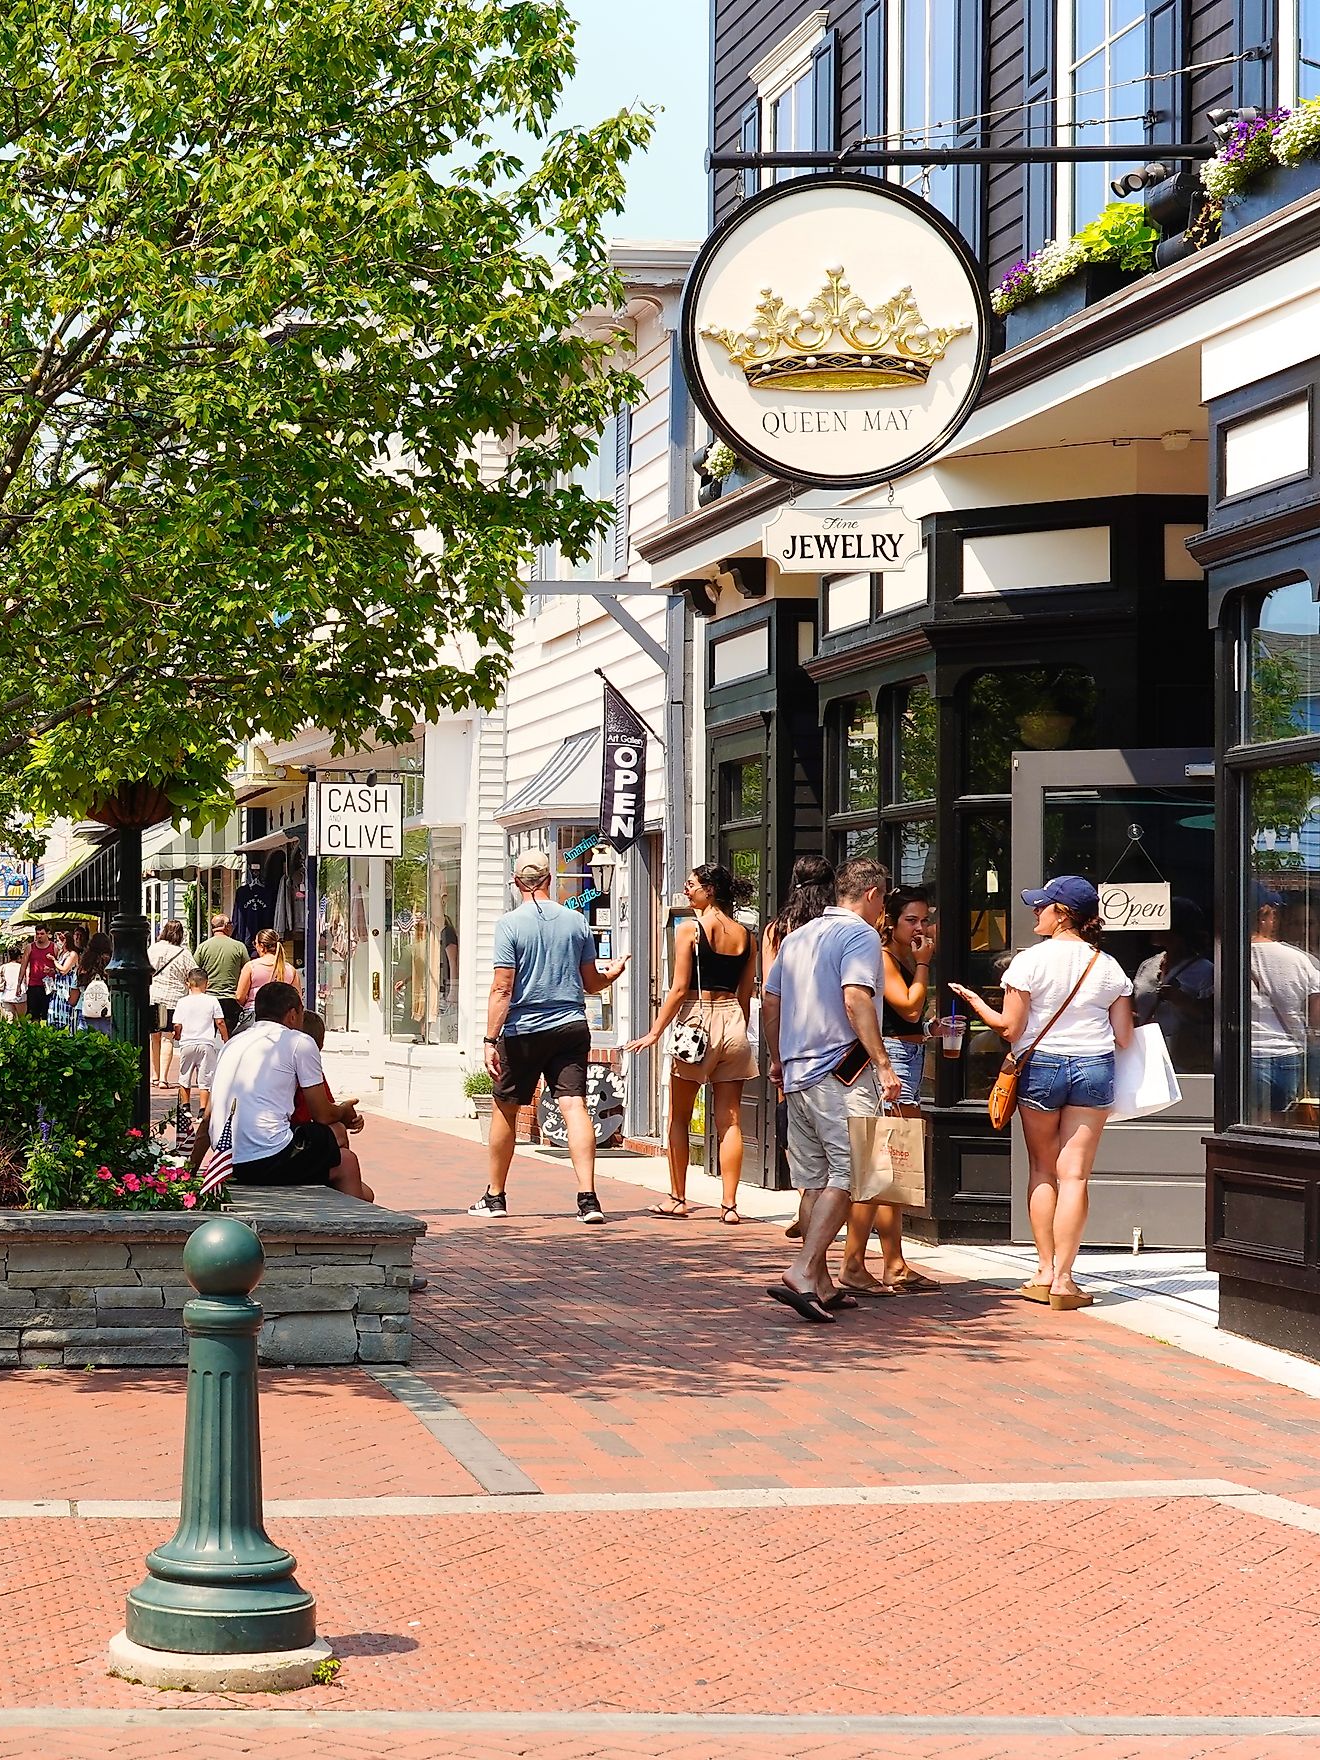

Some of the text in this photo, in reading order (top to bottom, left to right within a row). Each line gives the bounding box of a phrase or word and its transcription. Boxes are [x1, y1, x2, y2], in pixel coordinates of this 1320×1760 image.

[762, 410, 912, 438] QUEEN MAY
[822, 517, 859, 529] Fine
[782, 533, 904, 562] JEWELRY
[607, 734, 643, 746] Art Gallery
[329, 789, 388, 813] CASH
[610, 747, 638, 838] OPEN
[328, 825, 394, 849] CLIVE
[564, 834, 598, 862] Amazing
[1102, 888, 1167, 926] Open
[587, 1065, 606, 1079] APE
